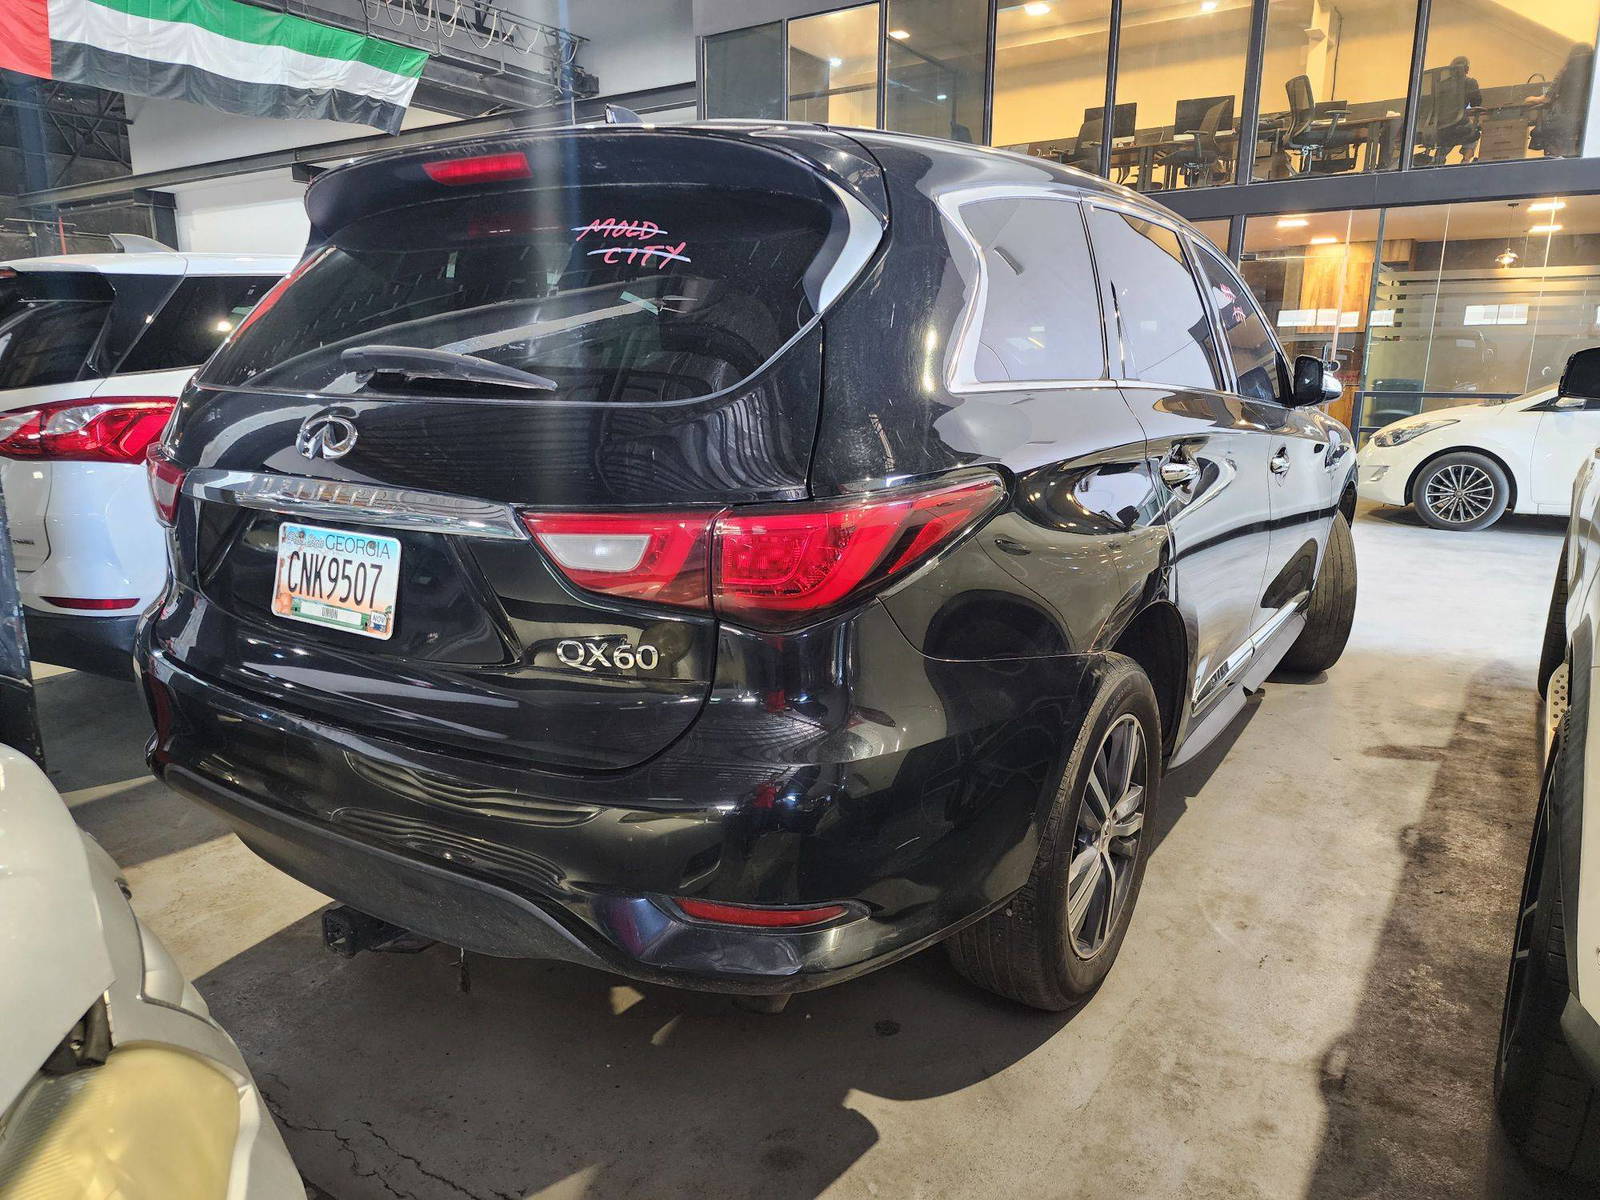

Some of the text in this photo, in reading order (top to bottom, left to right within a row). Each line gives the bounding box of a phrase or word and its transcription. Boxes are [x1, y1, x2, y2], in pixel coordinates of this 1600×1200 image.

[603, 241, 687, 270] CITY
[325, 534, 391, 560] GEORGIA
[287, 550, 383, 609] CNK9507
[556, 640, 659, 672] QX60
